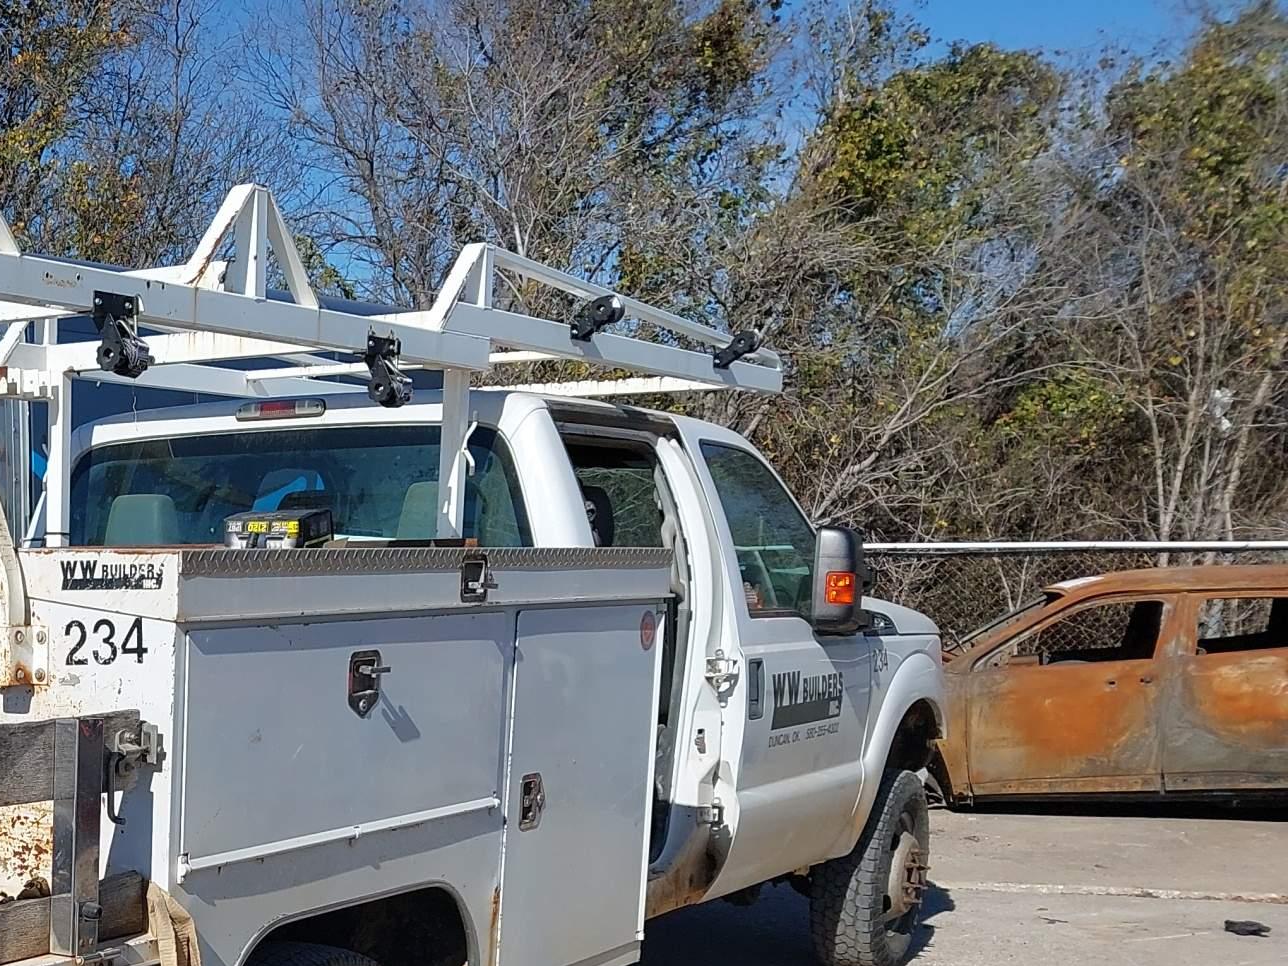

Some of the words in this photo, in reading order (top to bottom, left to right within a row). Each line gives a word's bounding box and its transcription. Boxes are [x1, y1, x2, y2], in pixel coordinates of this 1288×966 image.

[102, 563, 165, 579] BUILDERS
[64, 617, 148, 666] 234
[873, 648, 888, 672] 234
[802, 671, 843, 703] BUILDERS
